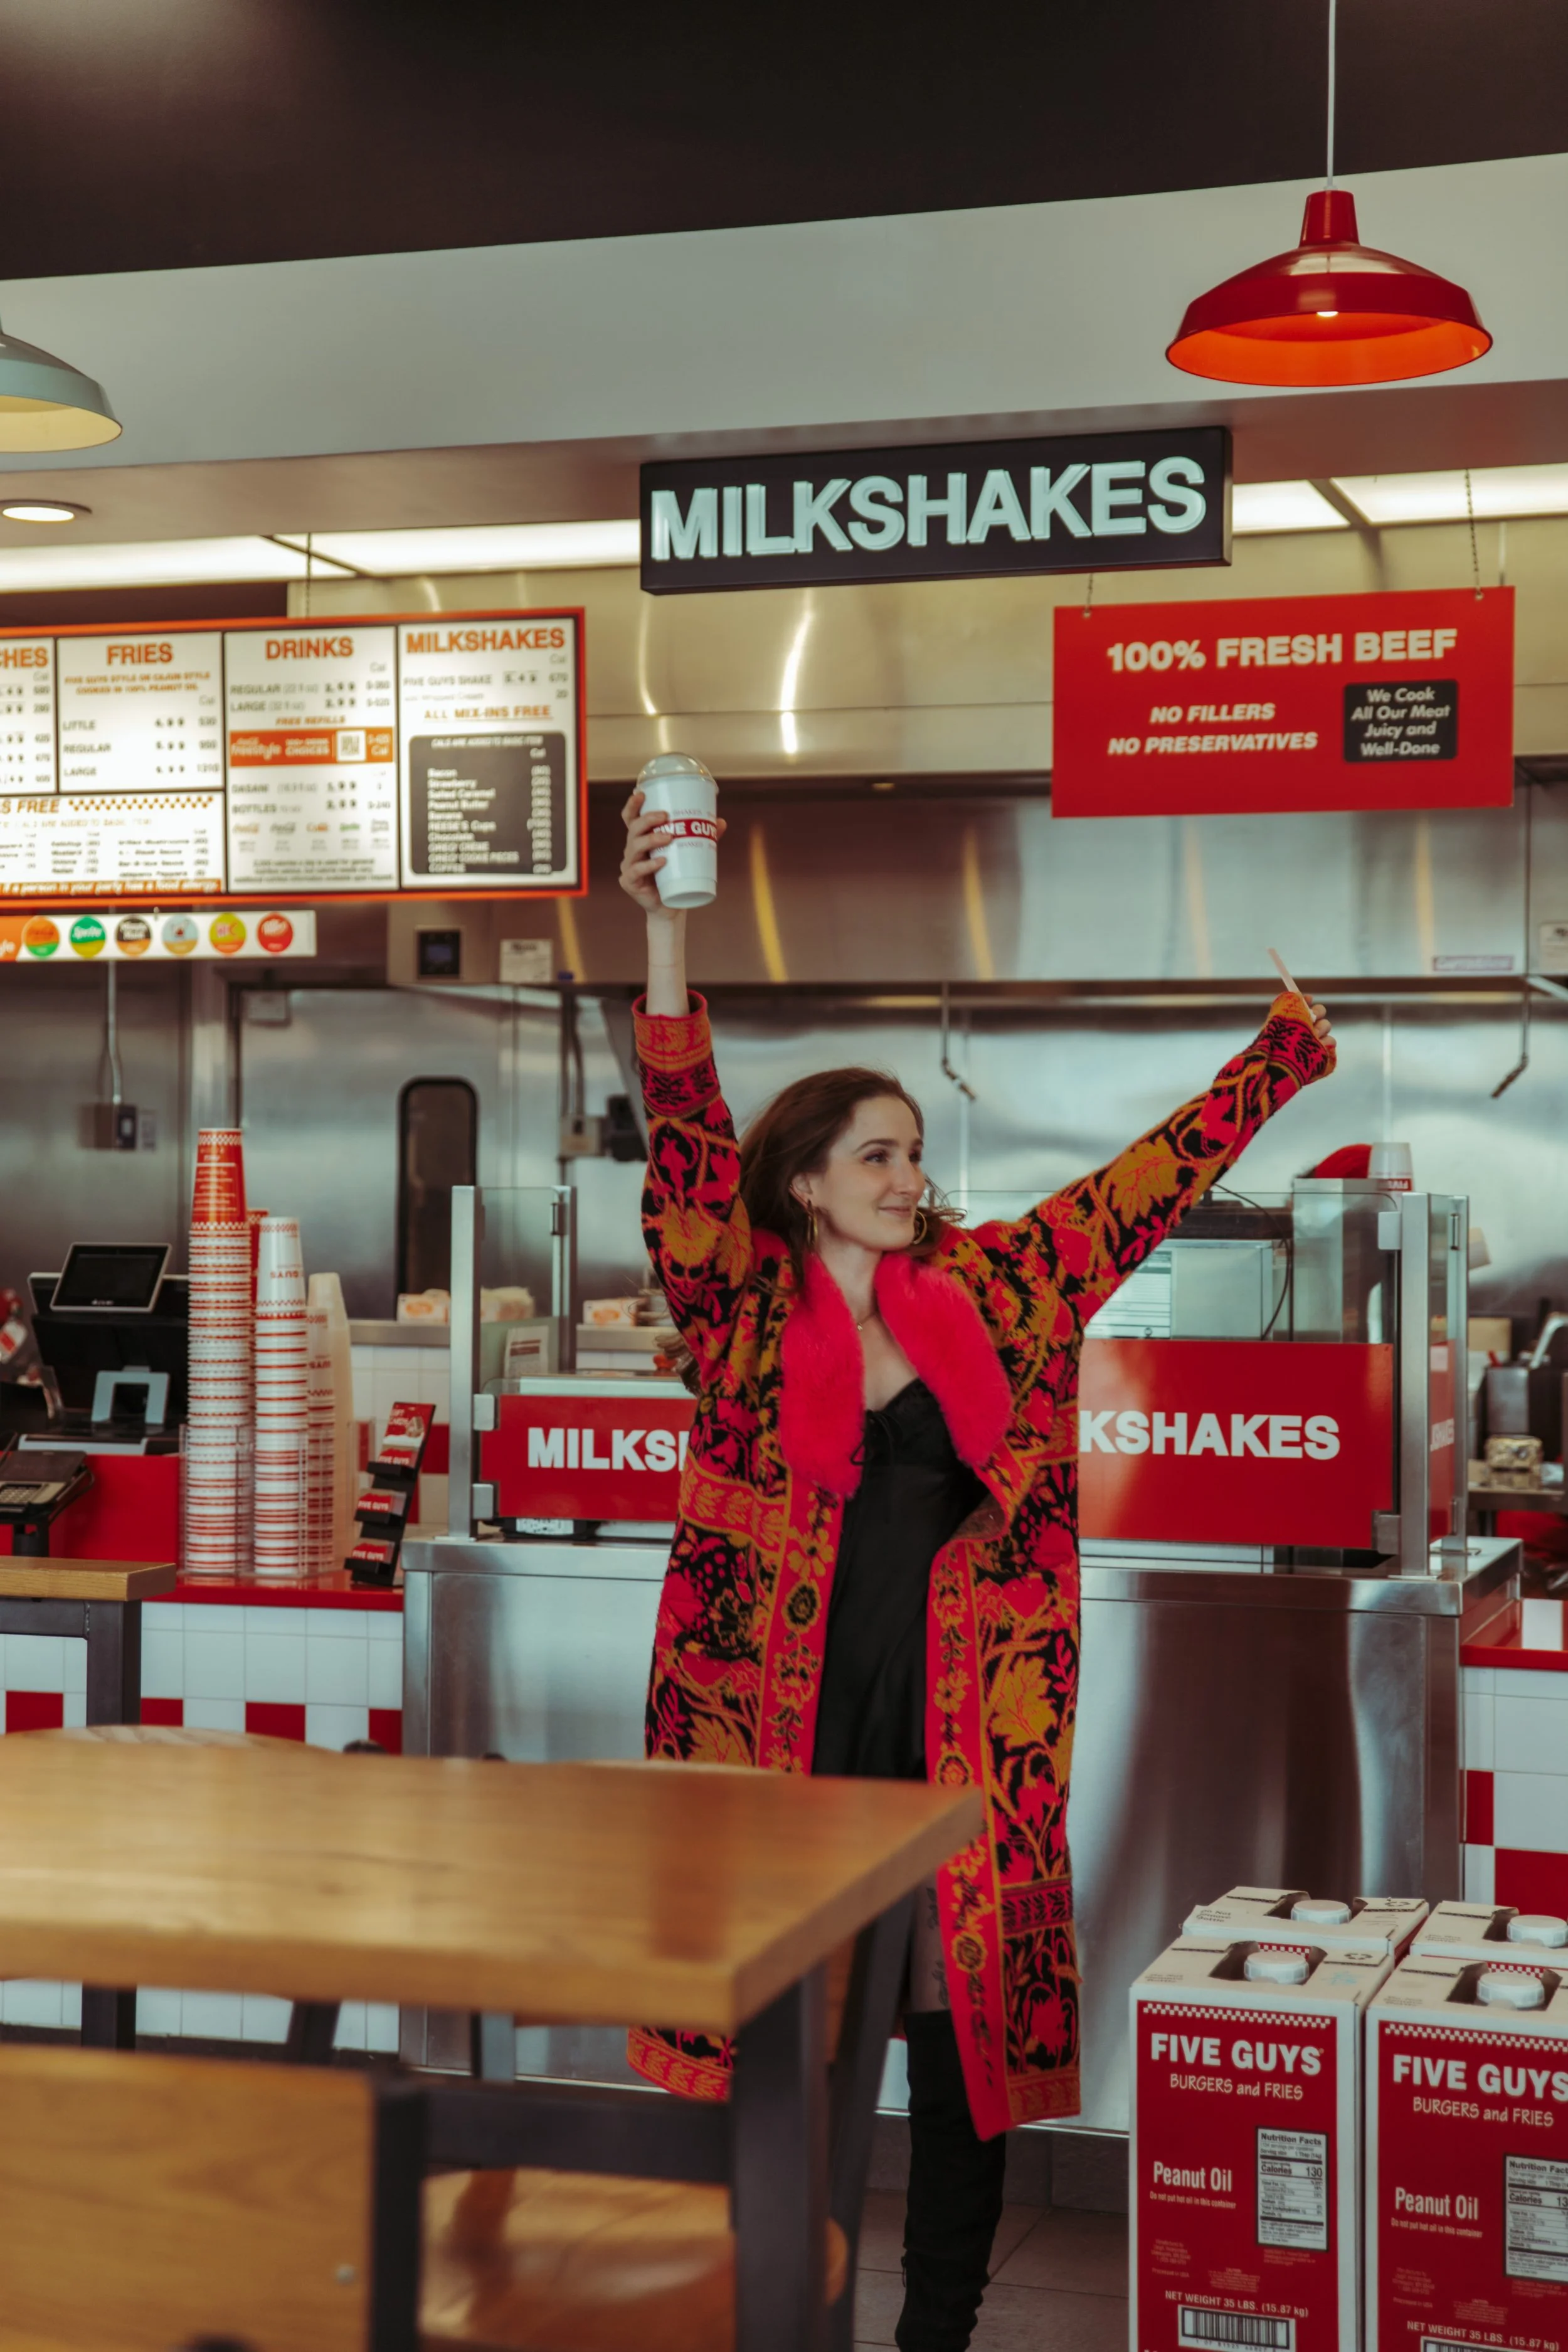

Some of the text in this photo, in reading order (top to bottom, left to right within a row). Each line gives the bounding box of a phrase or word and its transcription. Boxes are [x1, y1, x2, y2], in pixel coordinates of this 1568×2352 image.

[651, 455, 1206, 561] MILKSHAKES
[266, 637, 354, 660] DRINKS
[406, 628, 564, 654] MILKSHAKES
[1107, 628, 1457, 671] 100% FRESH BEEF
[0, 647, 48, 669] HES
[107, 642, 173, 665] FRIES
[1367, 687, 1435, 702] We Cook
[514, 706, 551, 717] FREE
[1149, 703, 1276, 724] NO FILLERS
[1351, 705, 1450, 720] All Our Meat
[1365, 722, 1436, 739] Juicy and
[1108, 733, 1318, 755] NO PRESERVATIVES
[1360, 742, 1440, 756] Well-Done
[0, 798, 60, 813] S FREE
[691, 821, 718, 840] GUY
[73, 926, 102, 939] Sprite
[393, 1456, 410, 1465] GUYS
[358, 1501, 389, 1511] FIVE GUYS
[352, 1550, 383, 1560] FIVE GUYS
[1151, 2032, 1322, 2075] FIVE GUYS
[1170, 2074, 1303, 2100] BURGERS and FRIES
[1392, 2053, 1568, 2102] FIVE GUYS
[1412, 2096, 1554, 2127] BURGERS and FRIES
[1261, 2133, 1322, 2145] Nutrition Facts
[1261, 2164, 1323, 2177] Calories 130
[1509, 2161, 1547, 2172] Nutrition
[1154, 2161, 1232, 2192] Peanut Oil
[1167, 2194, 1175, 2202] put
[1177, 2195, 1185, 2203] hot
[1200, 2198, 1210, 2206] this
[1211, 2200, 1236, 2209] container
[1396, 2186, 1478, 2220] Peanut Oil
[1509, 2193, 1542, 2204] Calories
[1456, 2228, 1483, 2238] container
[1165, 2291, 1308, 2318] NET WEIGHT 35 LBS. (15.87 kg)
[1407, 2321, 1559, 2351] NET WEIGHT 35 LBS. (15.87 kg)
